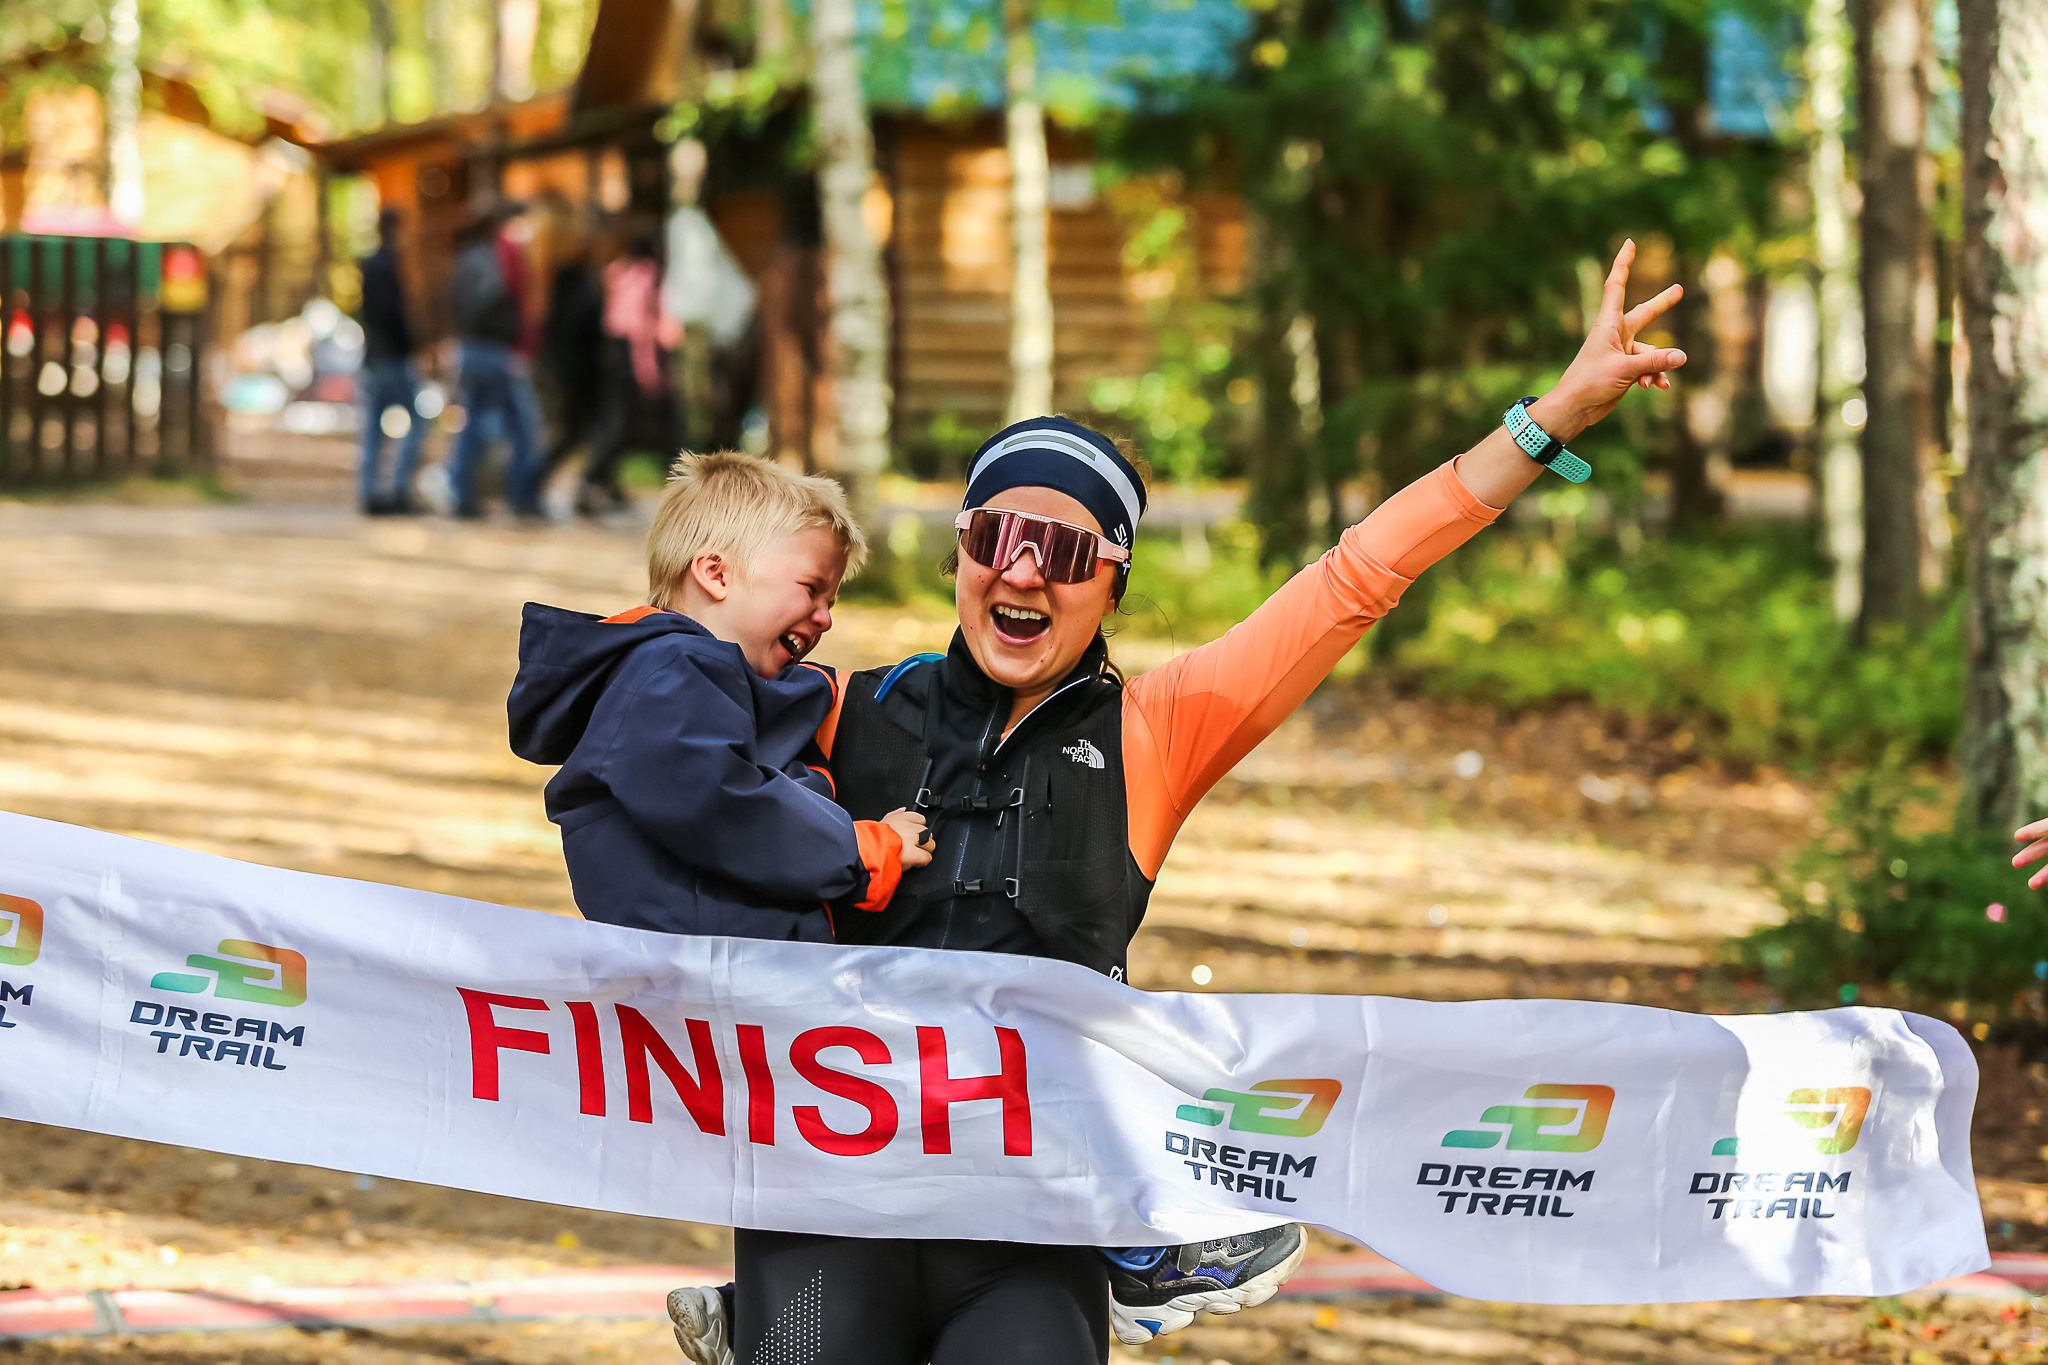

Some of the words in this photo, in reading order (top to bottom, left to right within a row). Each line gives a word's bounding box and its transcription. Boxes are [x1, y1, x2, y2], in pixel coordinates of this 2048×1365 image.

[1062, 746, 1090, 756] NORT
[1077, 739, 1090, 748] TH
[1072, 754, 1090, 764] FAC
[129, 1000, 306, 1047] DREAM
[149, 1030, 287, 1071] TRAIL
[456, 986, 1033, 1156] FINISH
[1165, 1130, 1318, 1179] DREAM
[1183, 1160, 1298, 1203] TRAIL
[1416, 1162, 1596, 1192] DREAM
[1688, 1170, 1852, 1194] DREAM
[1437, 1190, 1575, 1218] TRAIL
[1707, 1198, 1835, 1220] TRAIL
